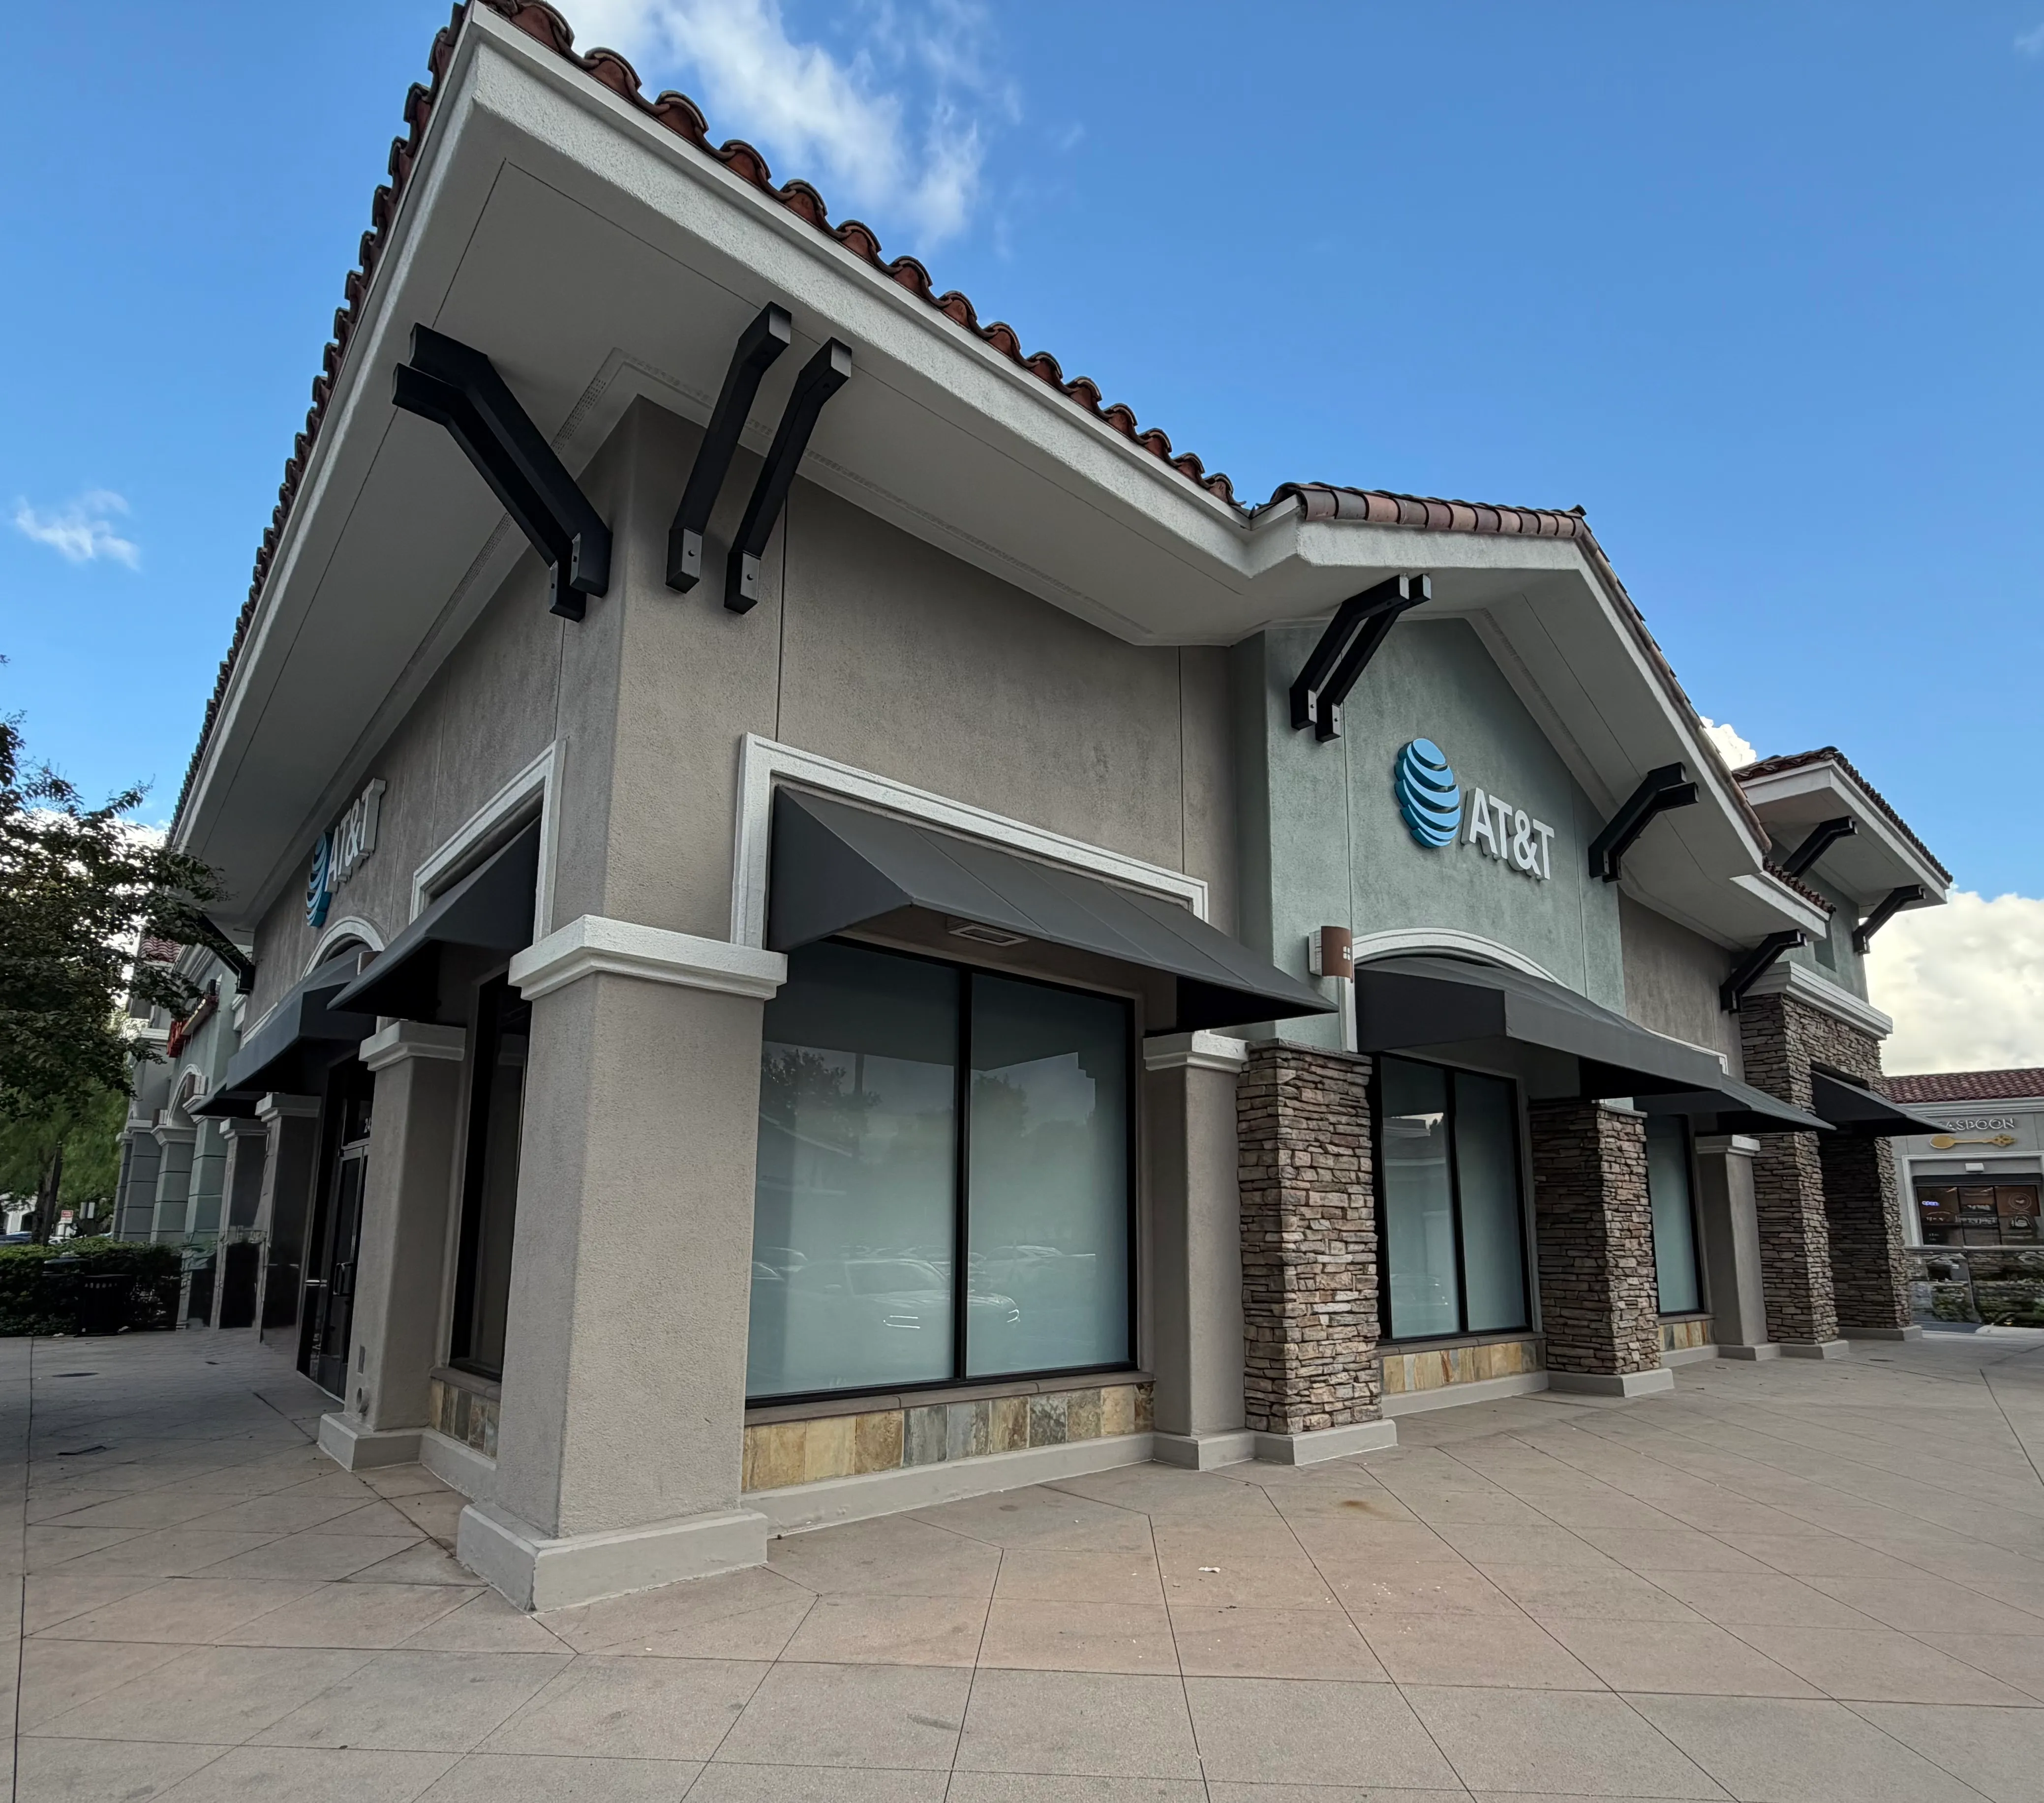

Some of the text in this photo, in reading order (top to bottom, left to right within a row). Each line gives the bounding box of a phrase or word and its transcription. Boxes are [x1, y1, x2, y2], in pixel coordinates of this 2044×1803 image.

[325, 778, 381, 892] AT&T
[1467, 787, 1555, 880] AT&T
[1939, 1117, 2015, 1131] ASPOON
